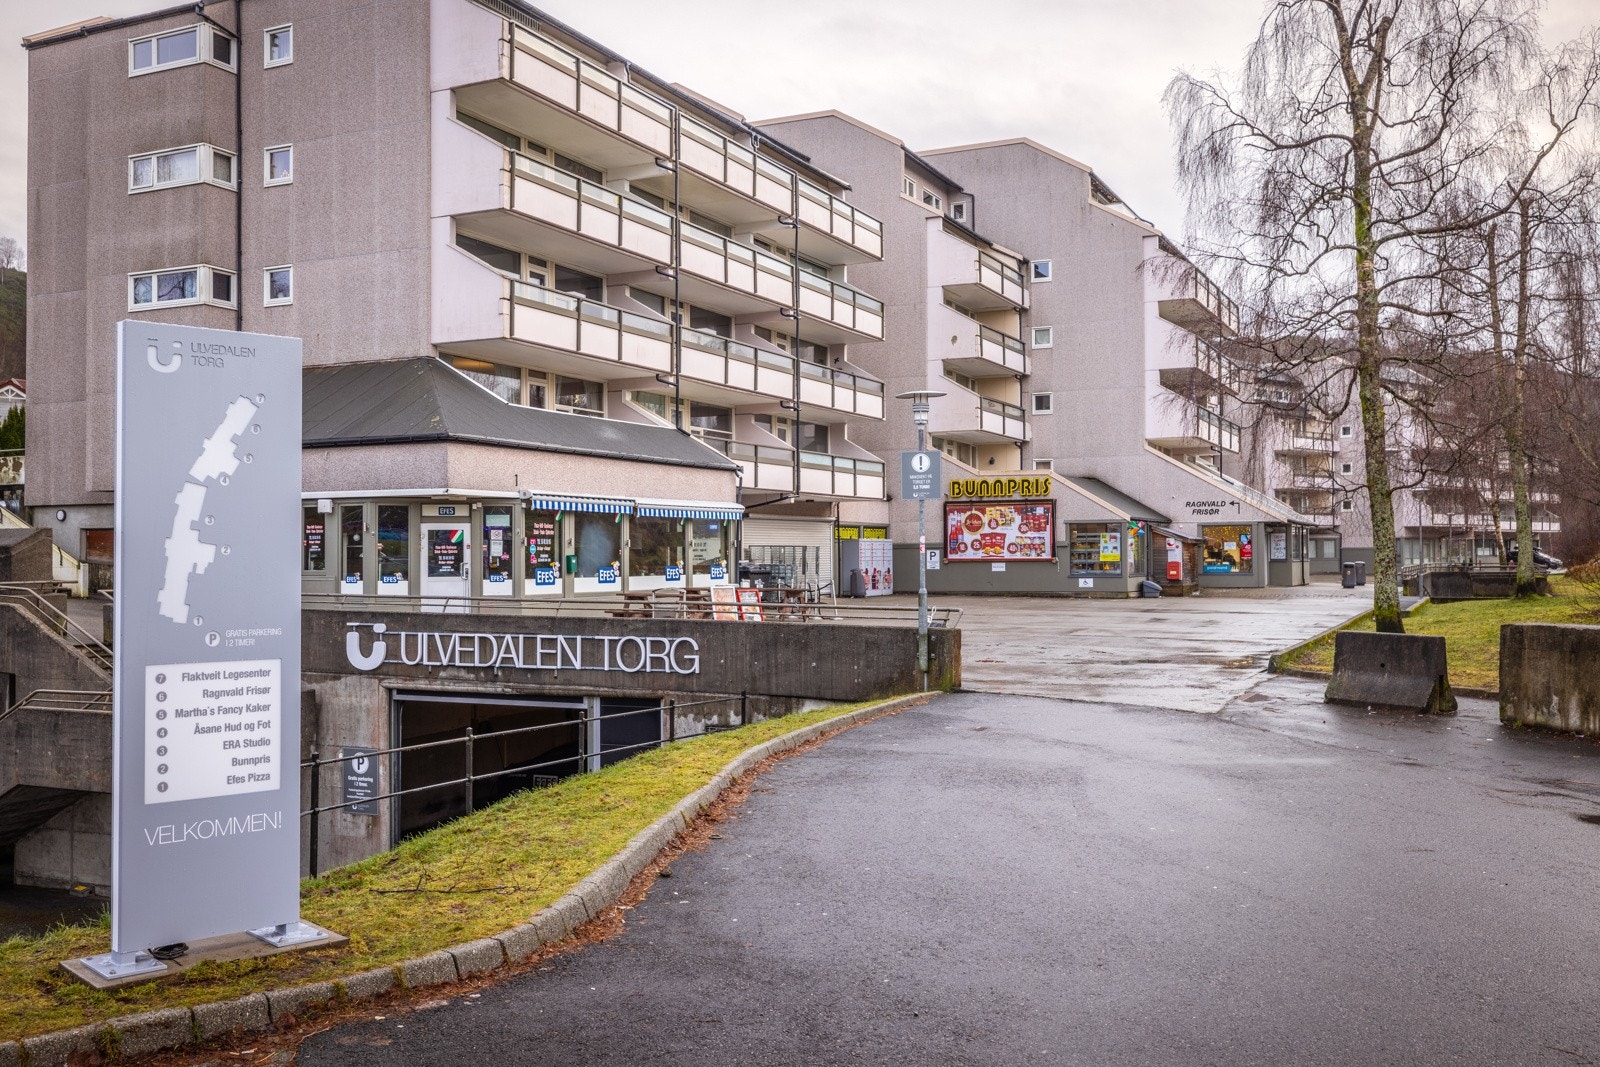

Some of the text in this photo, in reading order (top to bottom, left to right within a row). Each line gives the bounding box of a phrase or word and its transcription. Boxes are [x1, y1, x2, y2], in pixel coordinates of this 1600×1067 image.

[190, 341, 256, 358] ULVEDALEN
[191, 355, 225, 368] TORG
[949, 475, 1052, 498] BUNNPRIS
[439, 506, 454, 515] EFES
[1185, 500, 1227, 508] RAGNVALD
[1191, 508, 1220, 516] FRISØR
[929, 551, 937, 561] P
[490, 575, 505, 583] EFES
[537, 570, 554, 584] EFES
[599, 568, 615, 581] EFES
[666, 567, 680, 579] EFES
[710, 567, 723, 579] EFES
[383, 576, 398, 584] EFES
[209, 633, 217, 645] P
[225, 627, 282, 638] GRATIS PARKERING
[228, 639, 234, 647] 2
[400, 631, 700, 675] ULVEDALEN TORG
[181, 671, 221, 682] Flaktveit
[223, 668, 271, 682] Legesenter
[202, 687, 245, 701] Ragnvald
[246, 685, 271, 696] Frisør
[217, 705, 244, 717] Fancy
[245, 703, 271, 713] Kaker
[194, 721, 222, 735] Åsane
[224, 722, 242, 732] Hud
[243, 723, 256, 733] og
[257, 719, 271, 730] Fot
[223, 740, 241, 751] ERA
[243, 737, 271, 748] Studio
[231, 754, 271, 768] Bunnpris
[227, 774, 246, 785] Efes
[247, 772, 271, 783] Pizza
[144, 811, 282, 846] VELKOMMEN!
